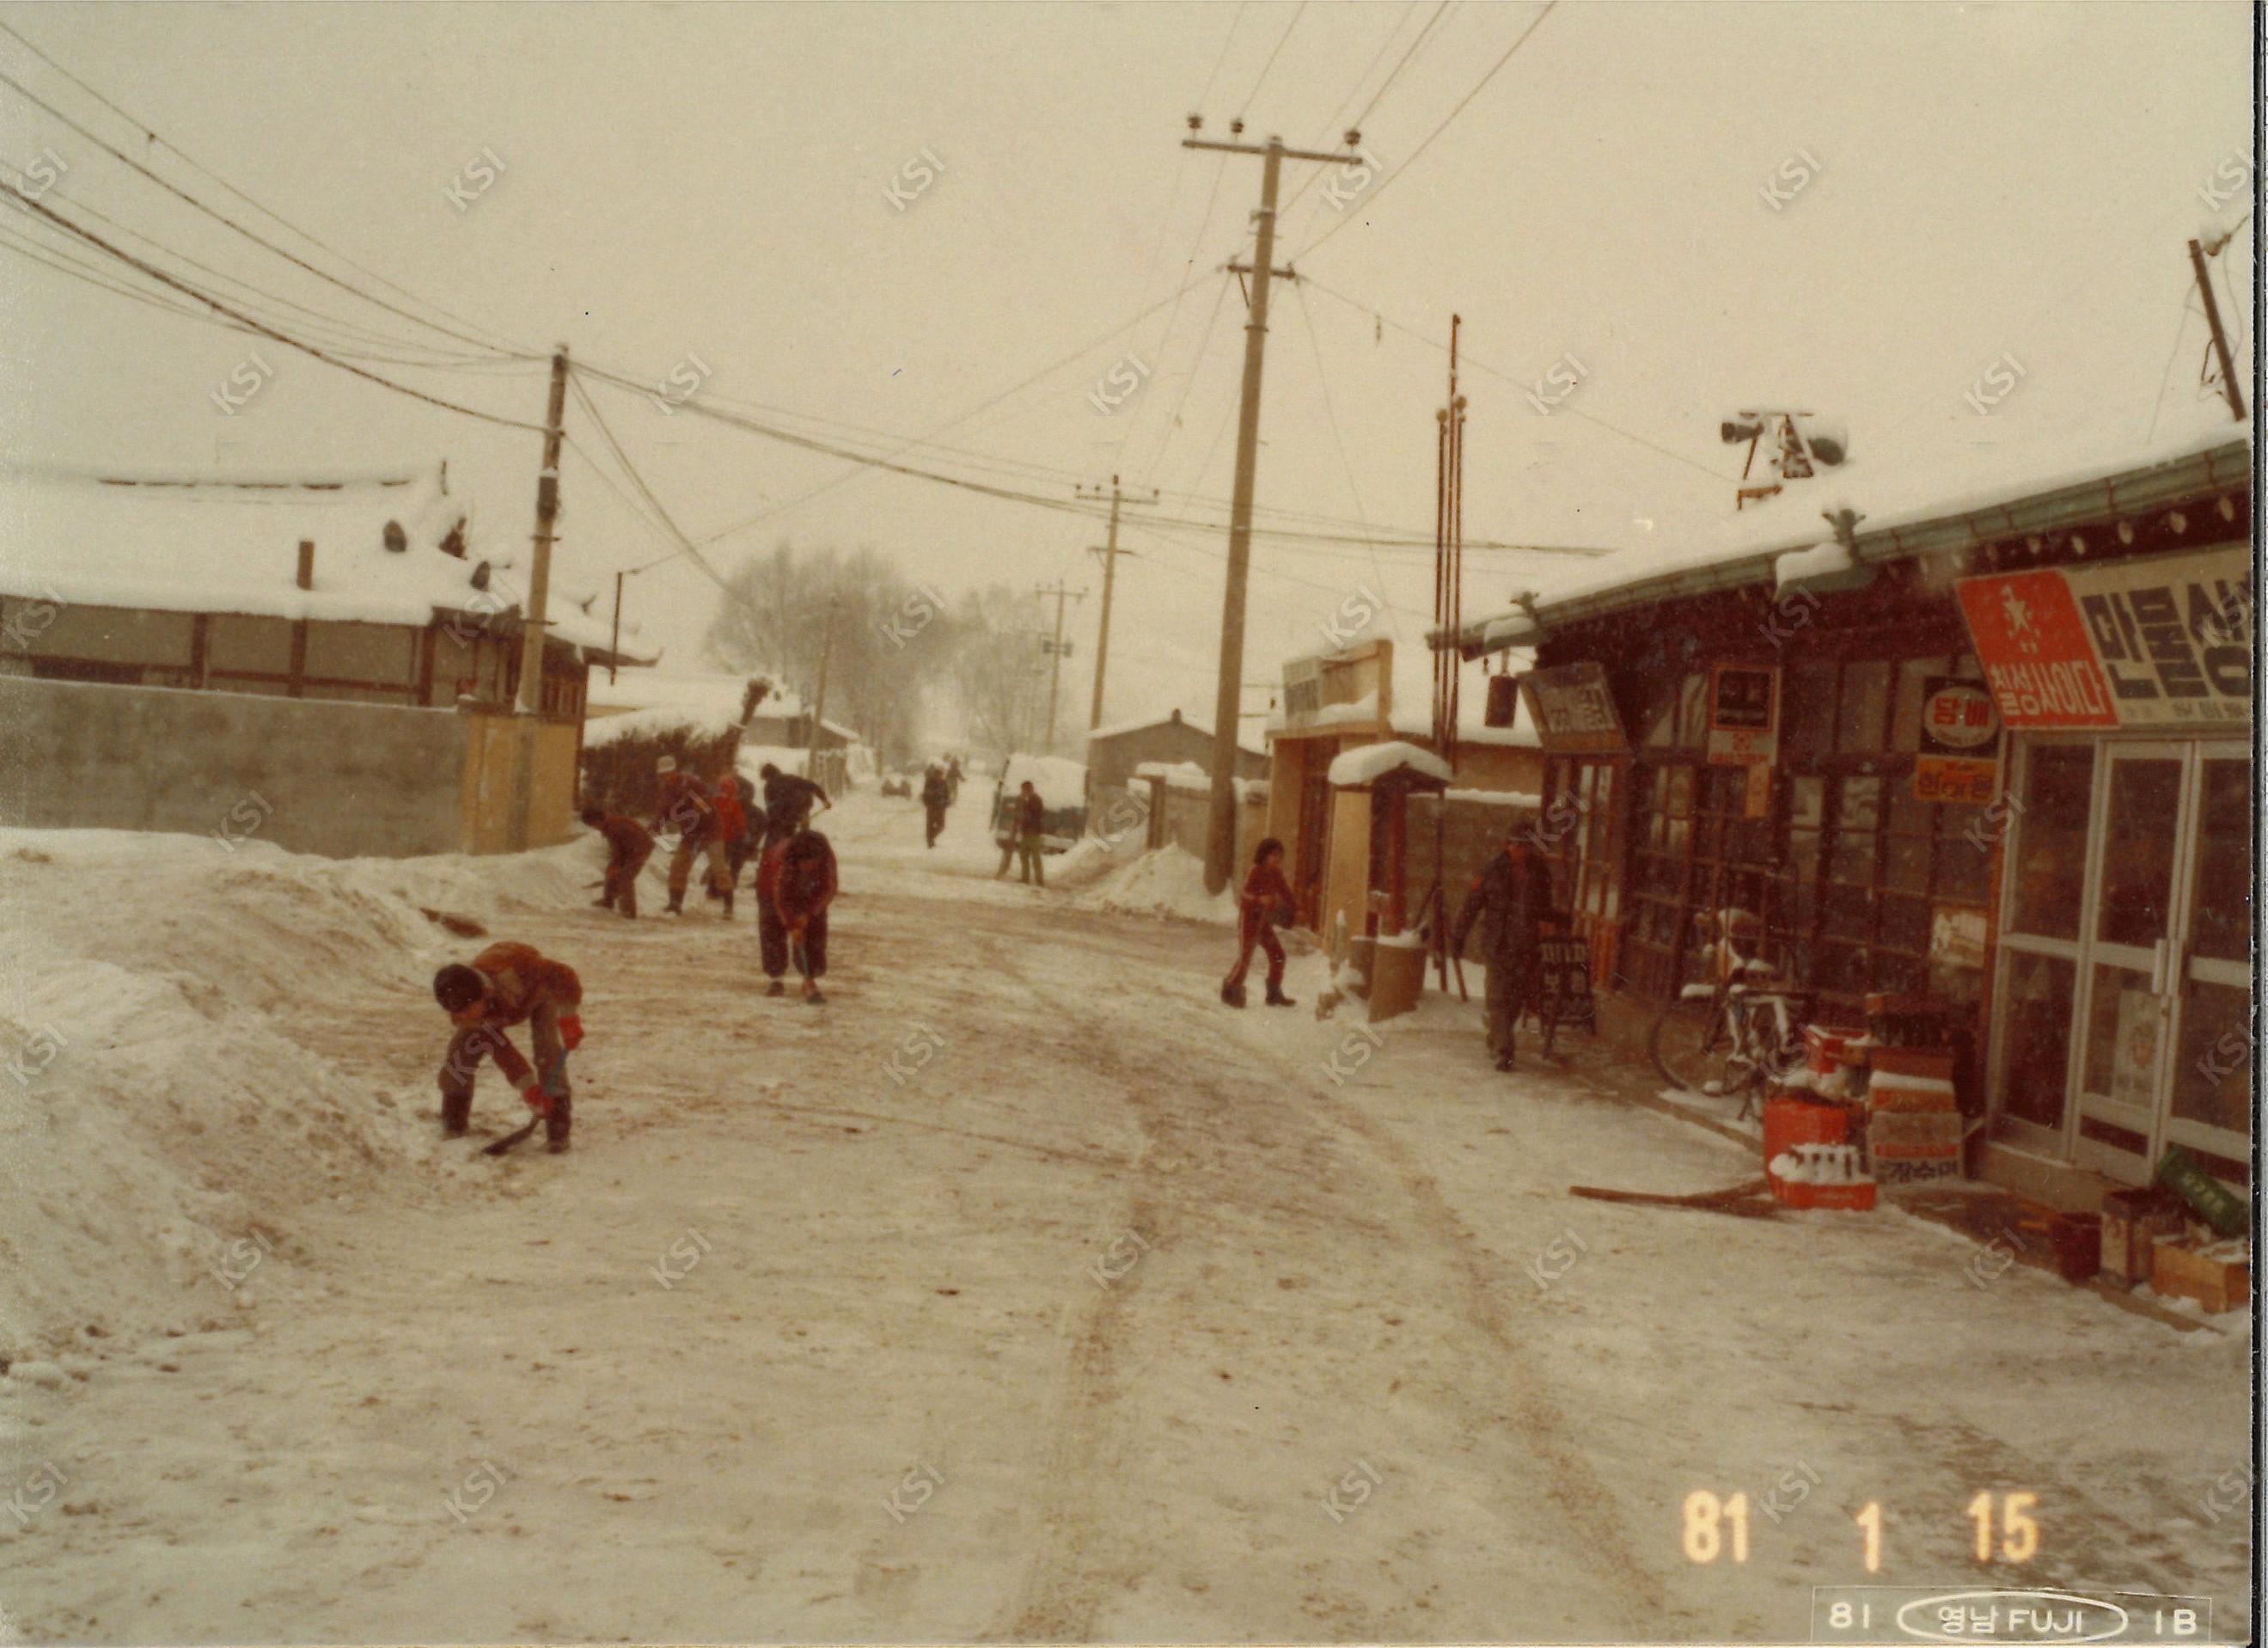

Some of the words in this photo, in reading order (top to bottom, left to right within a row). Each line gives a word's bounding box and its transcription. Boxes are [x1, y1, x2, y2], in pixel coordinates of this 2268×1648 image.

[2082, 571, 2250, 699] 만물상
[1934, 697, 1990, 728] 담배
[1990, 659, 2107, 716] 칠성사이다
